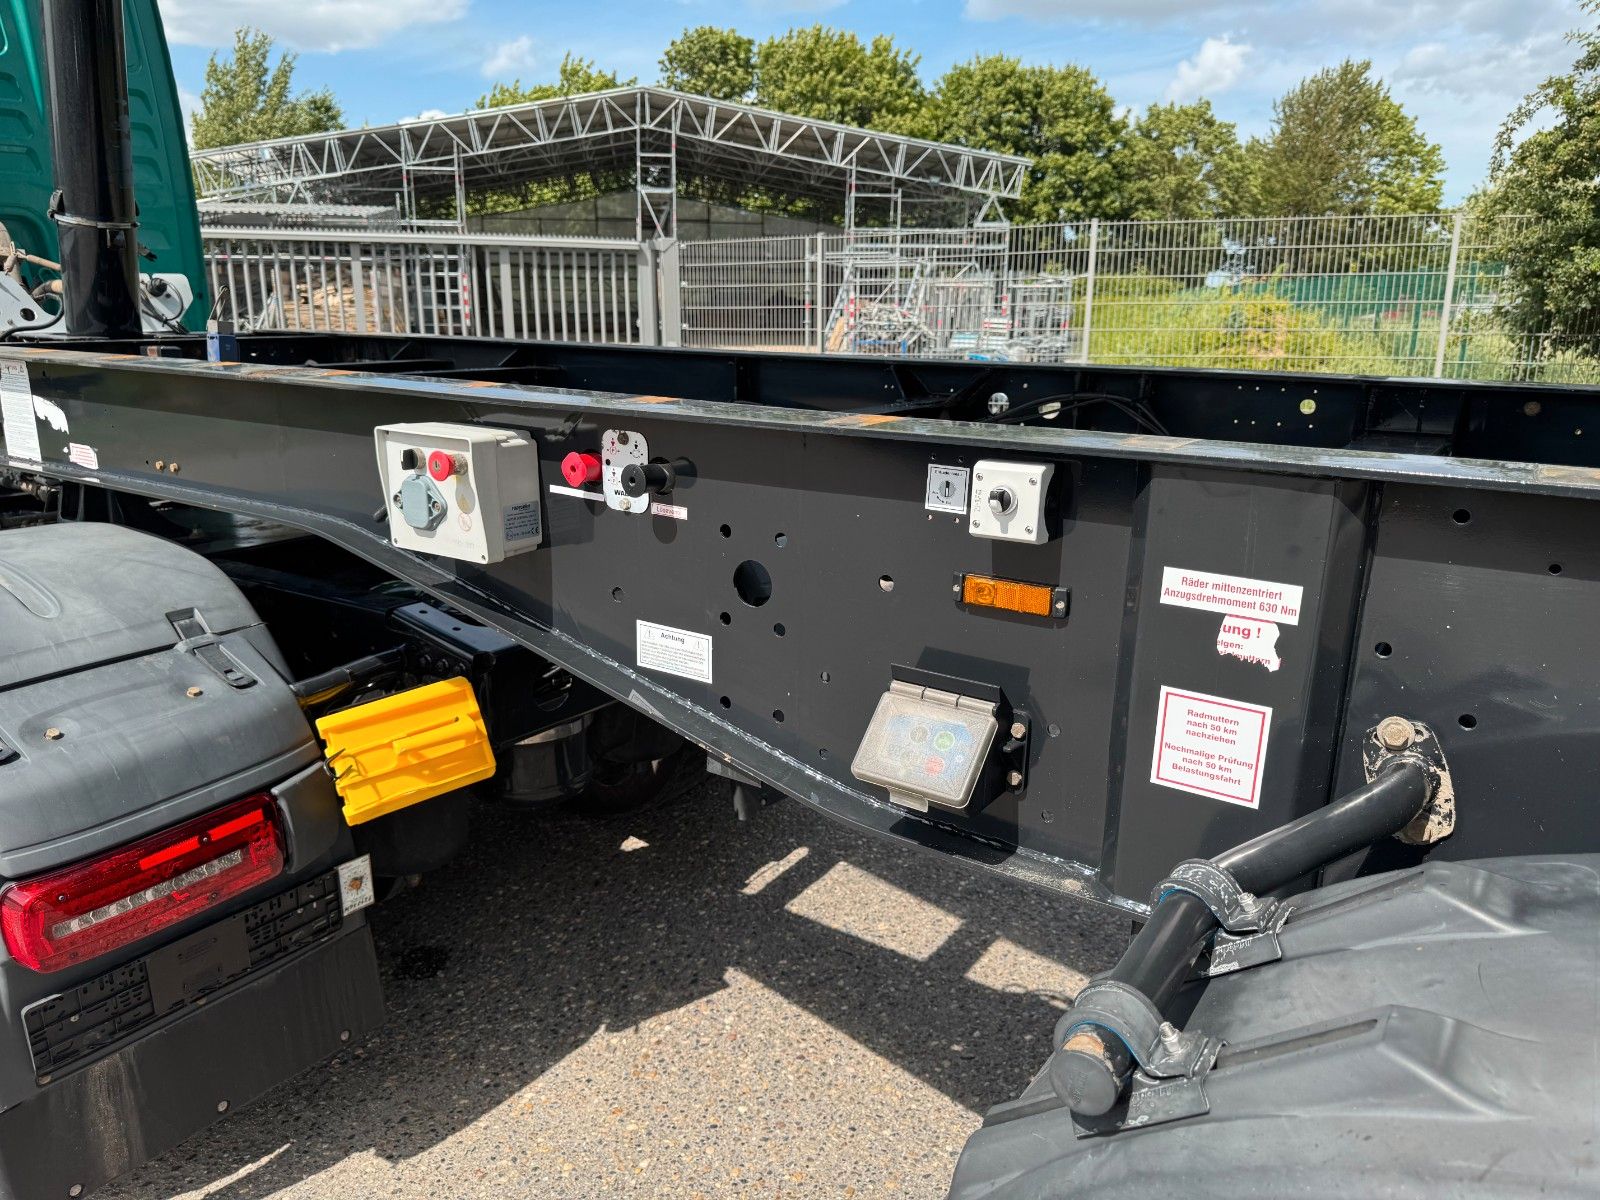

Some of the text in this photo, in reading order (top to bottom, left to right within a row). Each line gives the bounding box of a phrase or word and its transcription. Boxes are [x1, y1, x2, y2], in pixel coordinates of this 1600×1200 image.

[1181, 576, 1282, 601] Räder mittenzentriert
[1163, 587, 1297, 617] Anzugsdrehmoment 630 Nm
[660, 632, 685, 645] Achtung
[1187, 709, 1240, 726] Radmuttern
[1185, 728, 1237, 746] nachziehen
[1186, 720, 1238, 736] nach 50 km
[1164, 742, 1254, 771] Nochmalige Prüfung
[1182, 756, 1232, 774] nach 50 km
[1171, 762, 1242, 786] Belastungsfahrt
